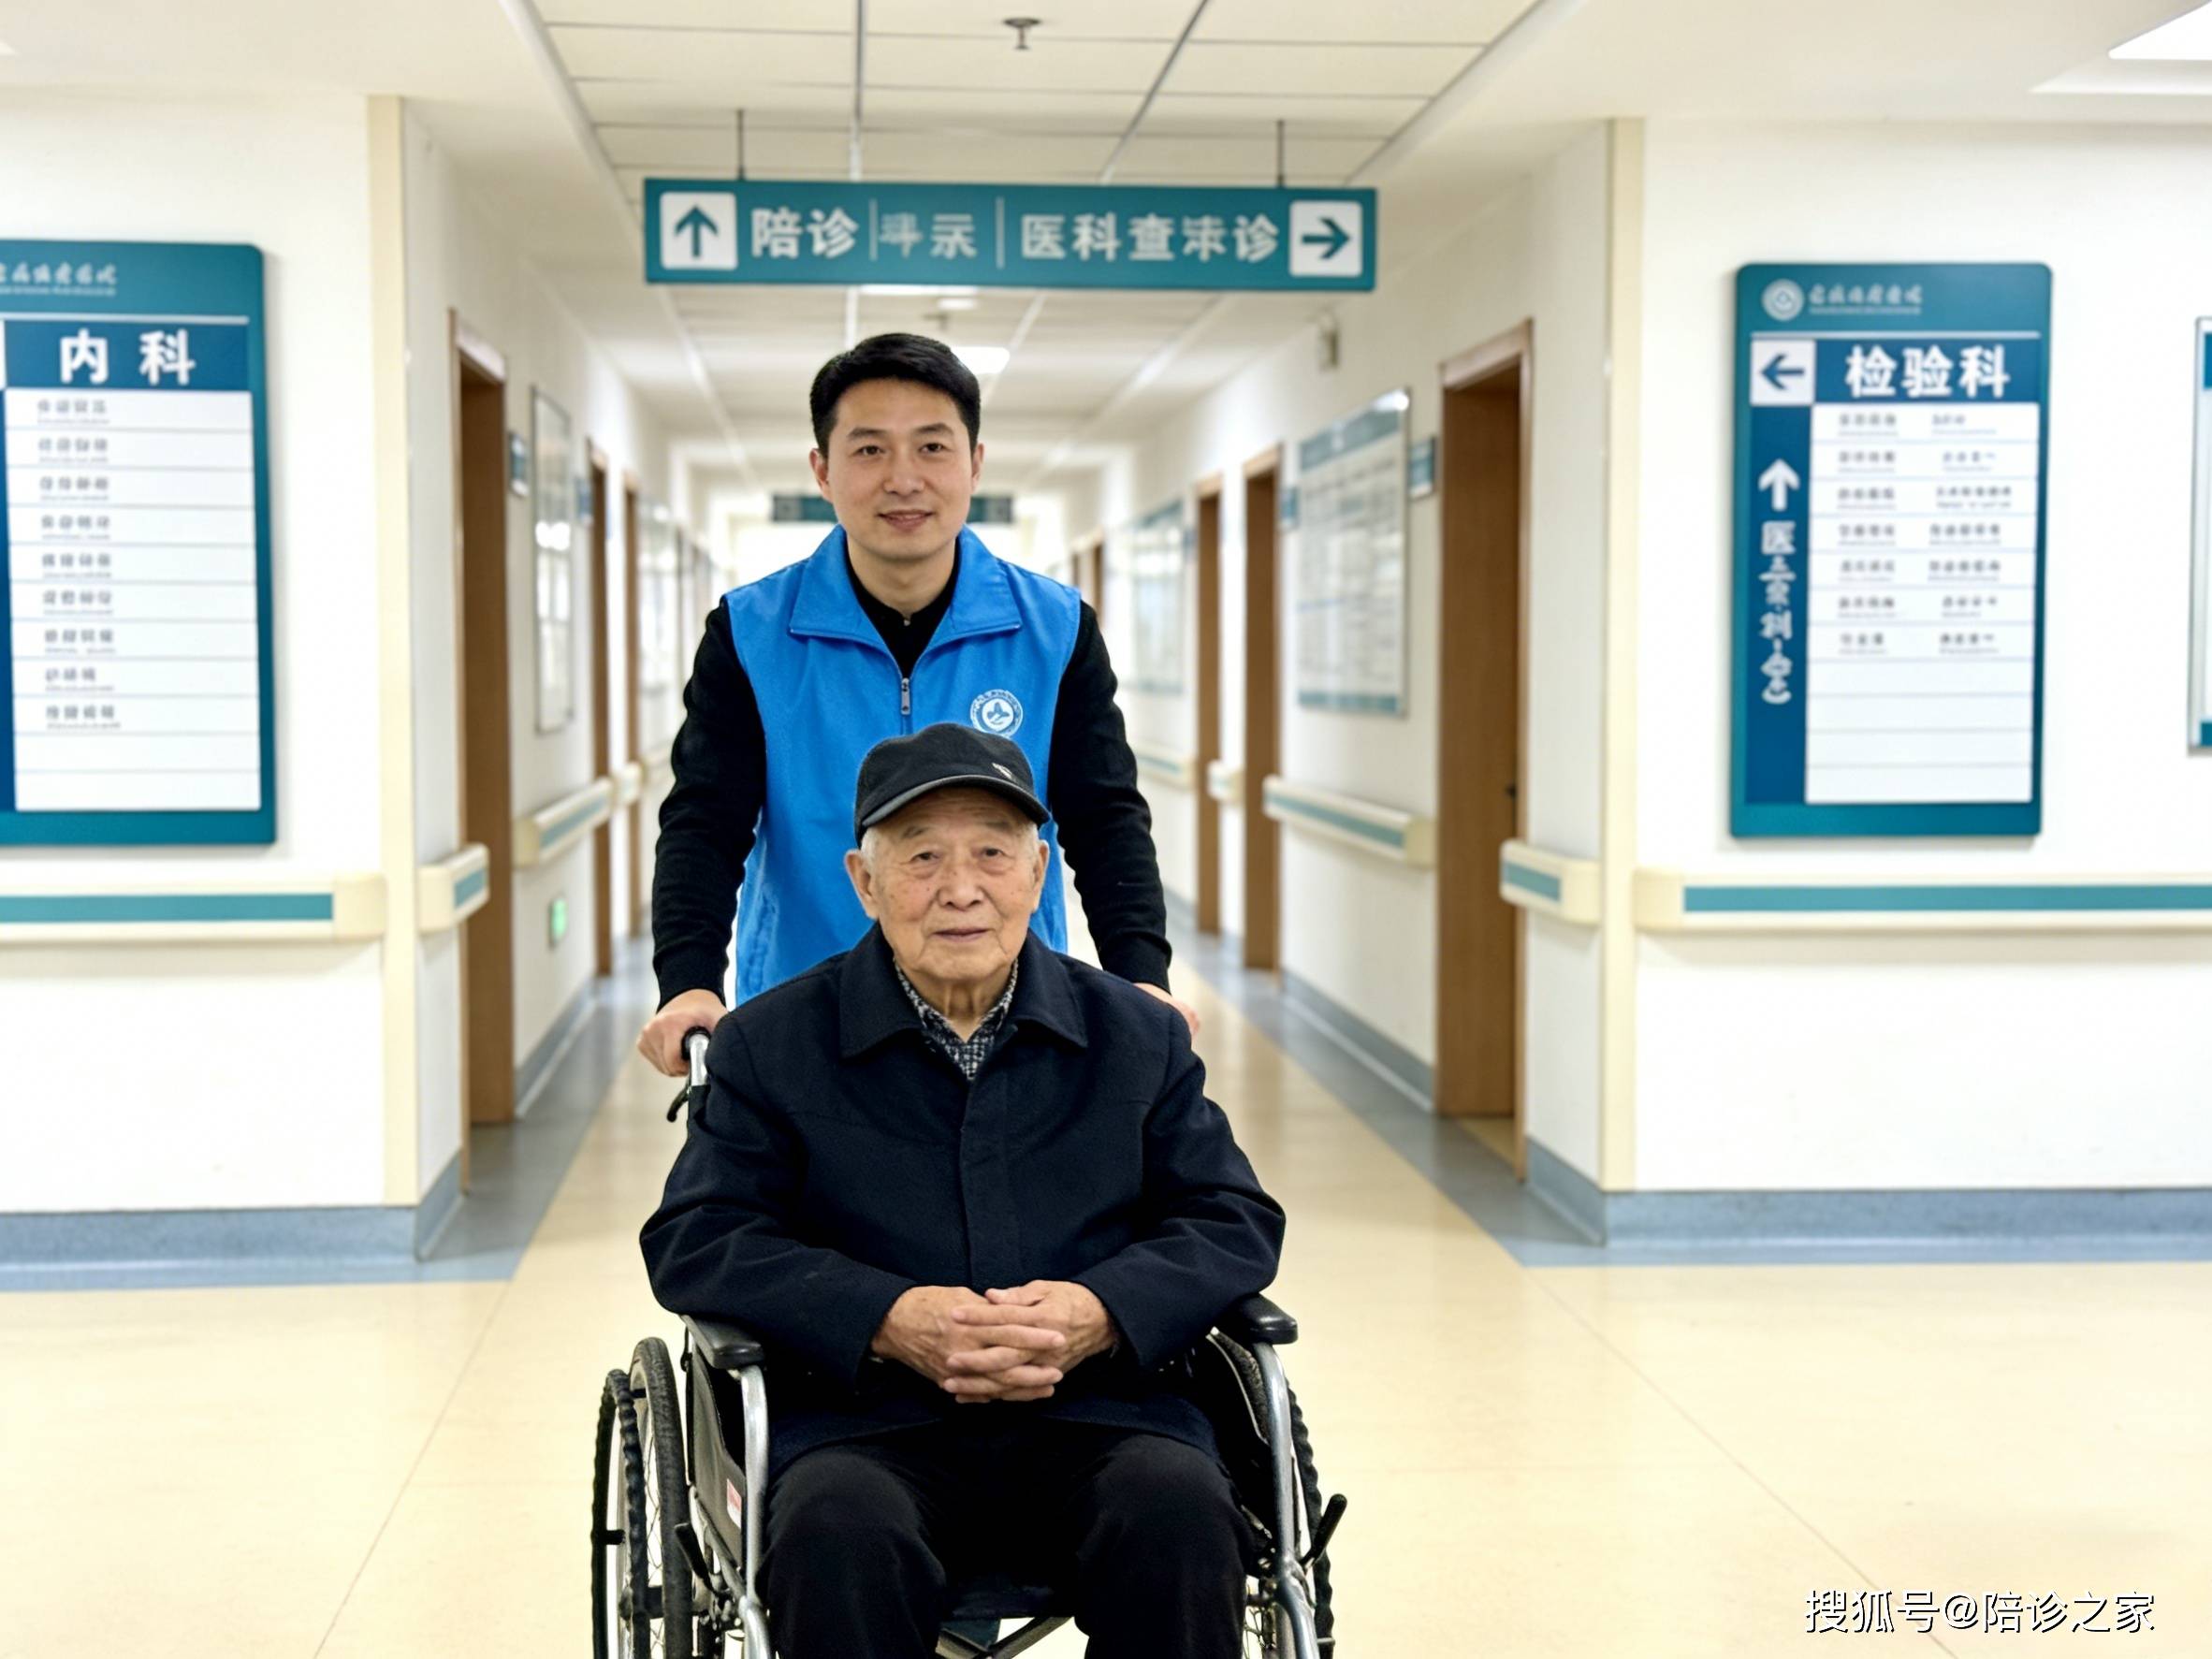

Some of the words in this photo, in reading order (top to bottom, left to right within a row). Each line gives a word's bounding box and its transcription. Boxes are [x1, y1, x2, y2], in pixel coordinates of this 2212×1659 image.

[750, 206, 859, 259] 陪诊
[59, 327, 196, 386] 内科
[1844, 343, 2011, 399] 检验科
